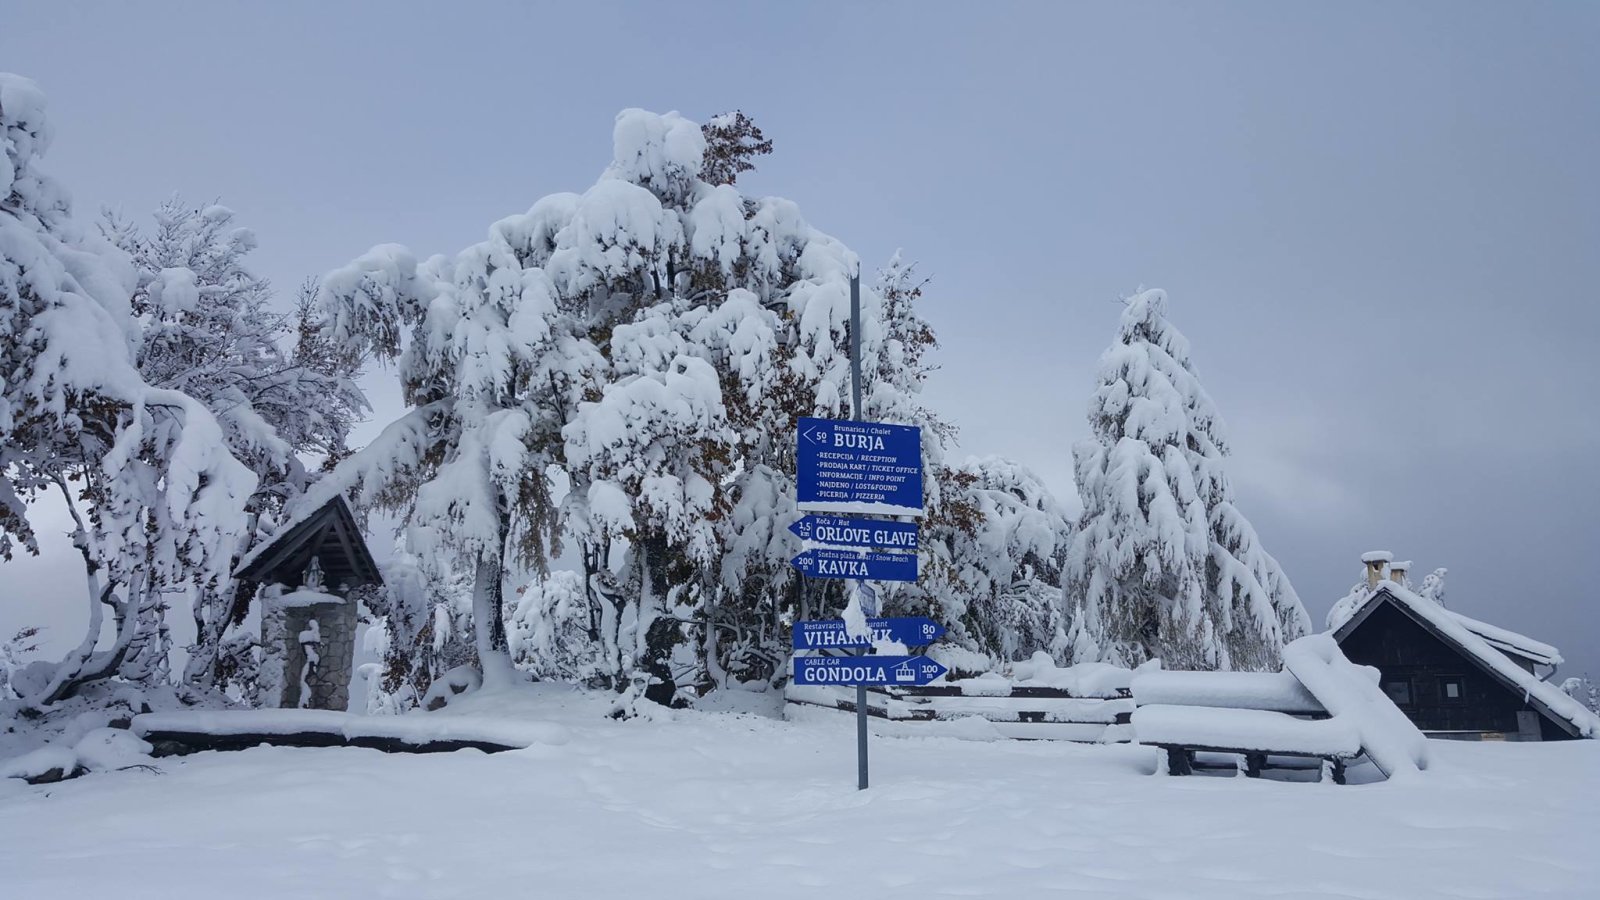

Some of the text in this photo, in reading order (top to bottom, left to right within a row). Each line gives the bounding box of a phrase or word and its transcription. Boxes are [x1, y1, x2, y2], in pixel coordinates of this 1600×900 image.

[834, 425, 865, 433] Brunarica
[816, 432, 827, 441] 50
[834, 433, 885, 451] BURJA
[820, 452, 854, 460] RECEPCIJA
[861, 455, 897, 463] RECEPTION
[820, 462, 848, 470] PRODAJA
[820, 472, 863, 480] INFORMACIJE
[820, 481, 850, 489] NAJDENO
[855, 483, 898, 491] LOST&FOUND
[820, 491, 848, 499] PICERIJA
[855, 492, 885, 500] PIZZERIA
[799, 522, 811, 531] 1,5
[816, 526, 916, 546] ORLOVE GLAVE
[798, 557, 813, 565] 200
[818, 560, 869, 576] KAVKA
[922, 624, 936, 634] 80
[922, 665, 938, 673] 100
[804, 667, 887, 682] GONDOLA
